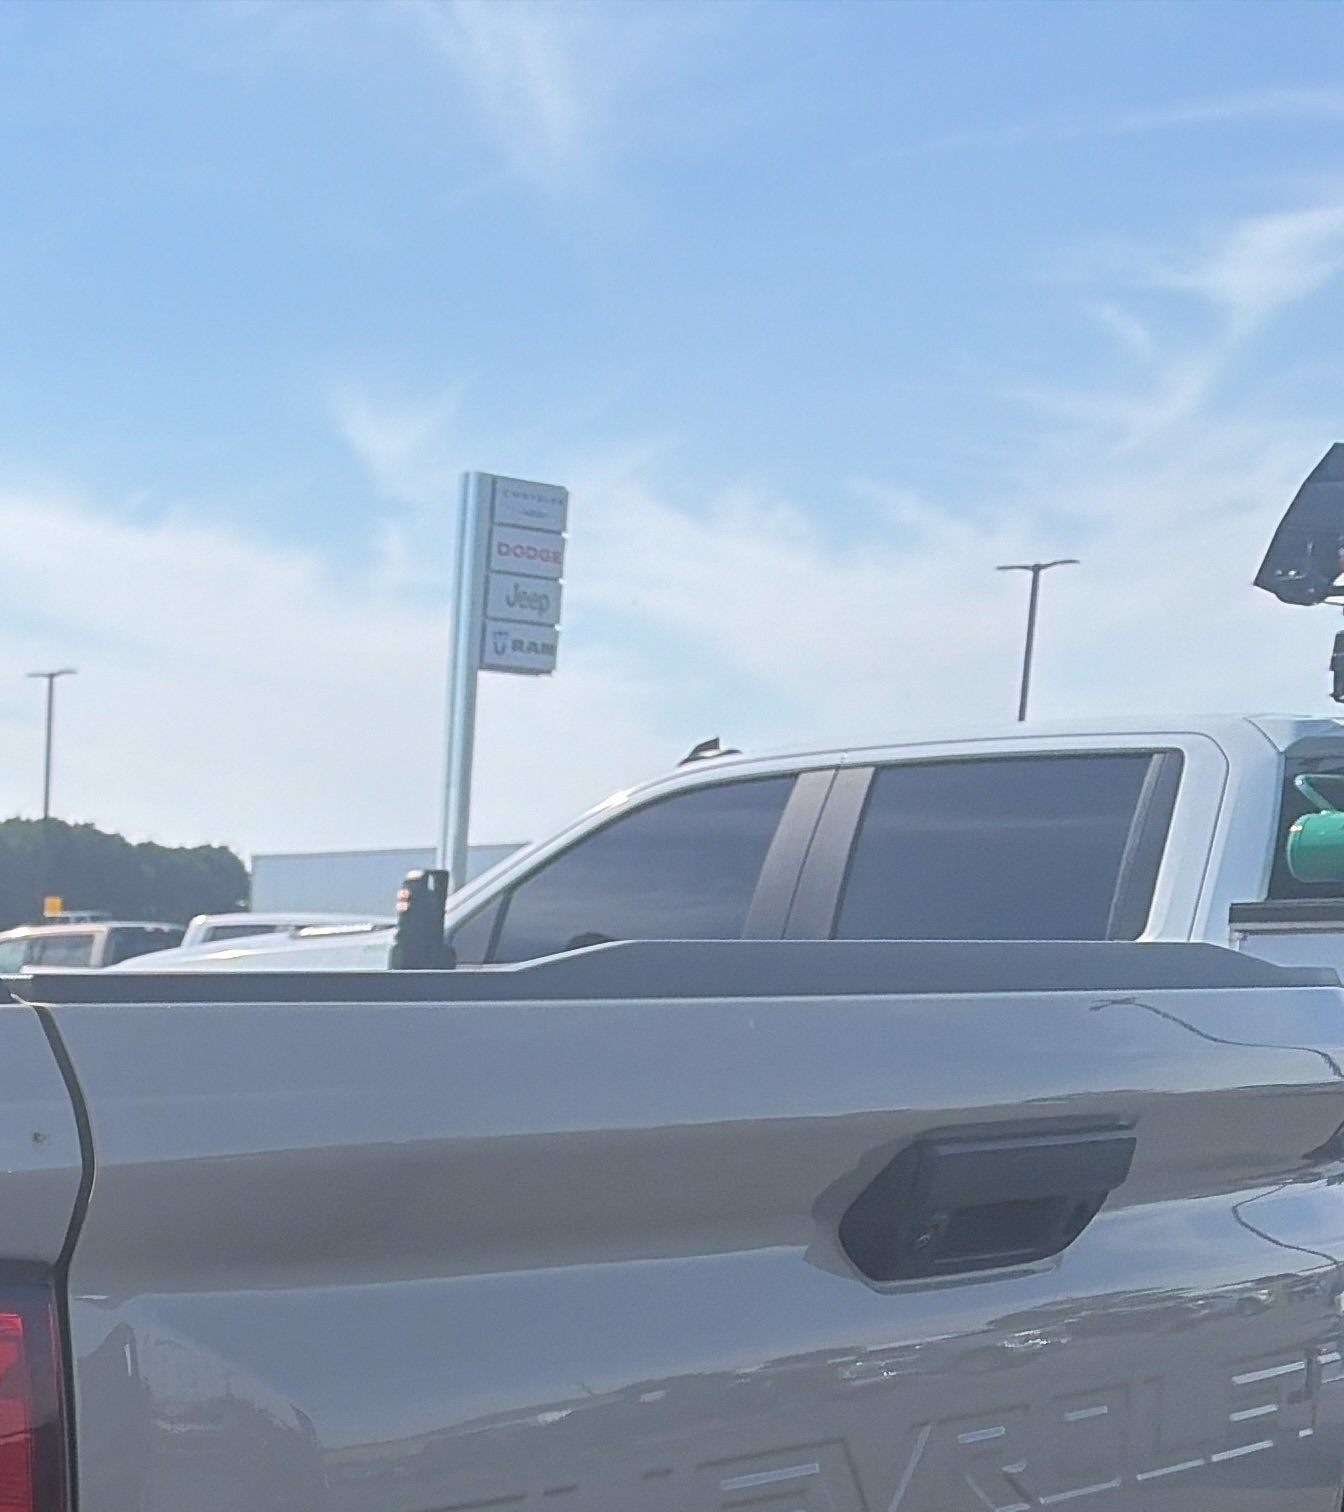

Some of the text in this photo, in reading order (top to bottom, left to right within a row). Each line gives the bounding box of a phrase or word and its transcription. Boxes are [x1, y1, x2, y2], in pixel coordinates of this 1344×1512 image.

[497, 542, 562, 564] DODGE
[506, 582, 551, 616] Jeep
[512, 639, 556, 656] RAM
